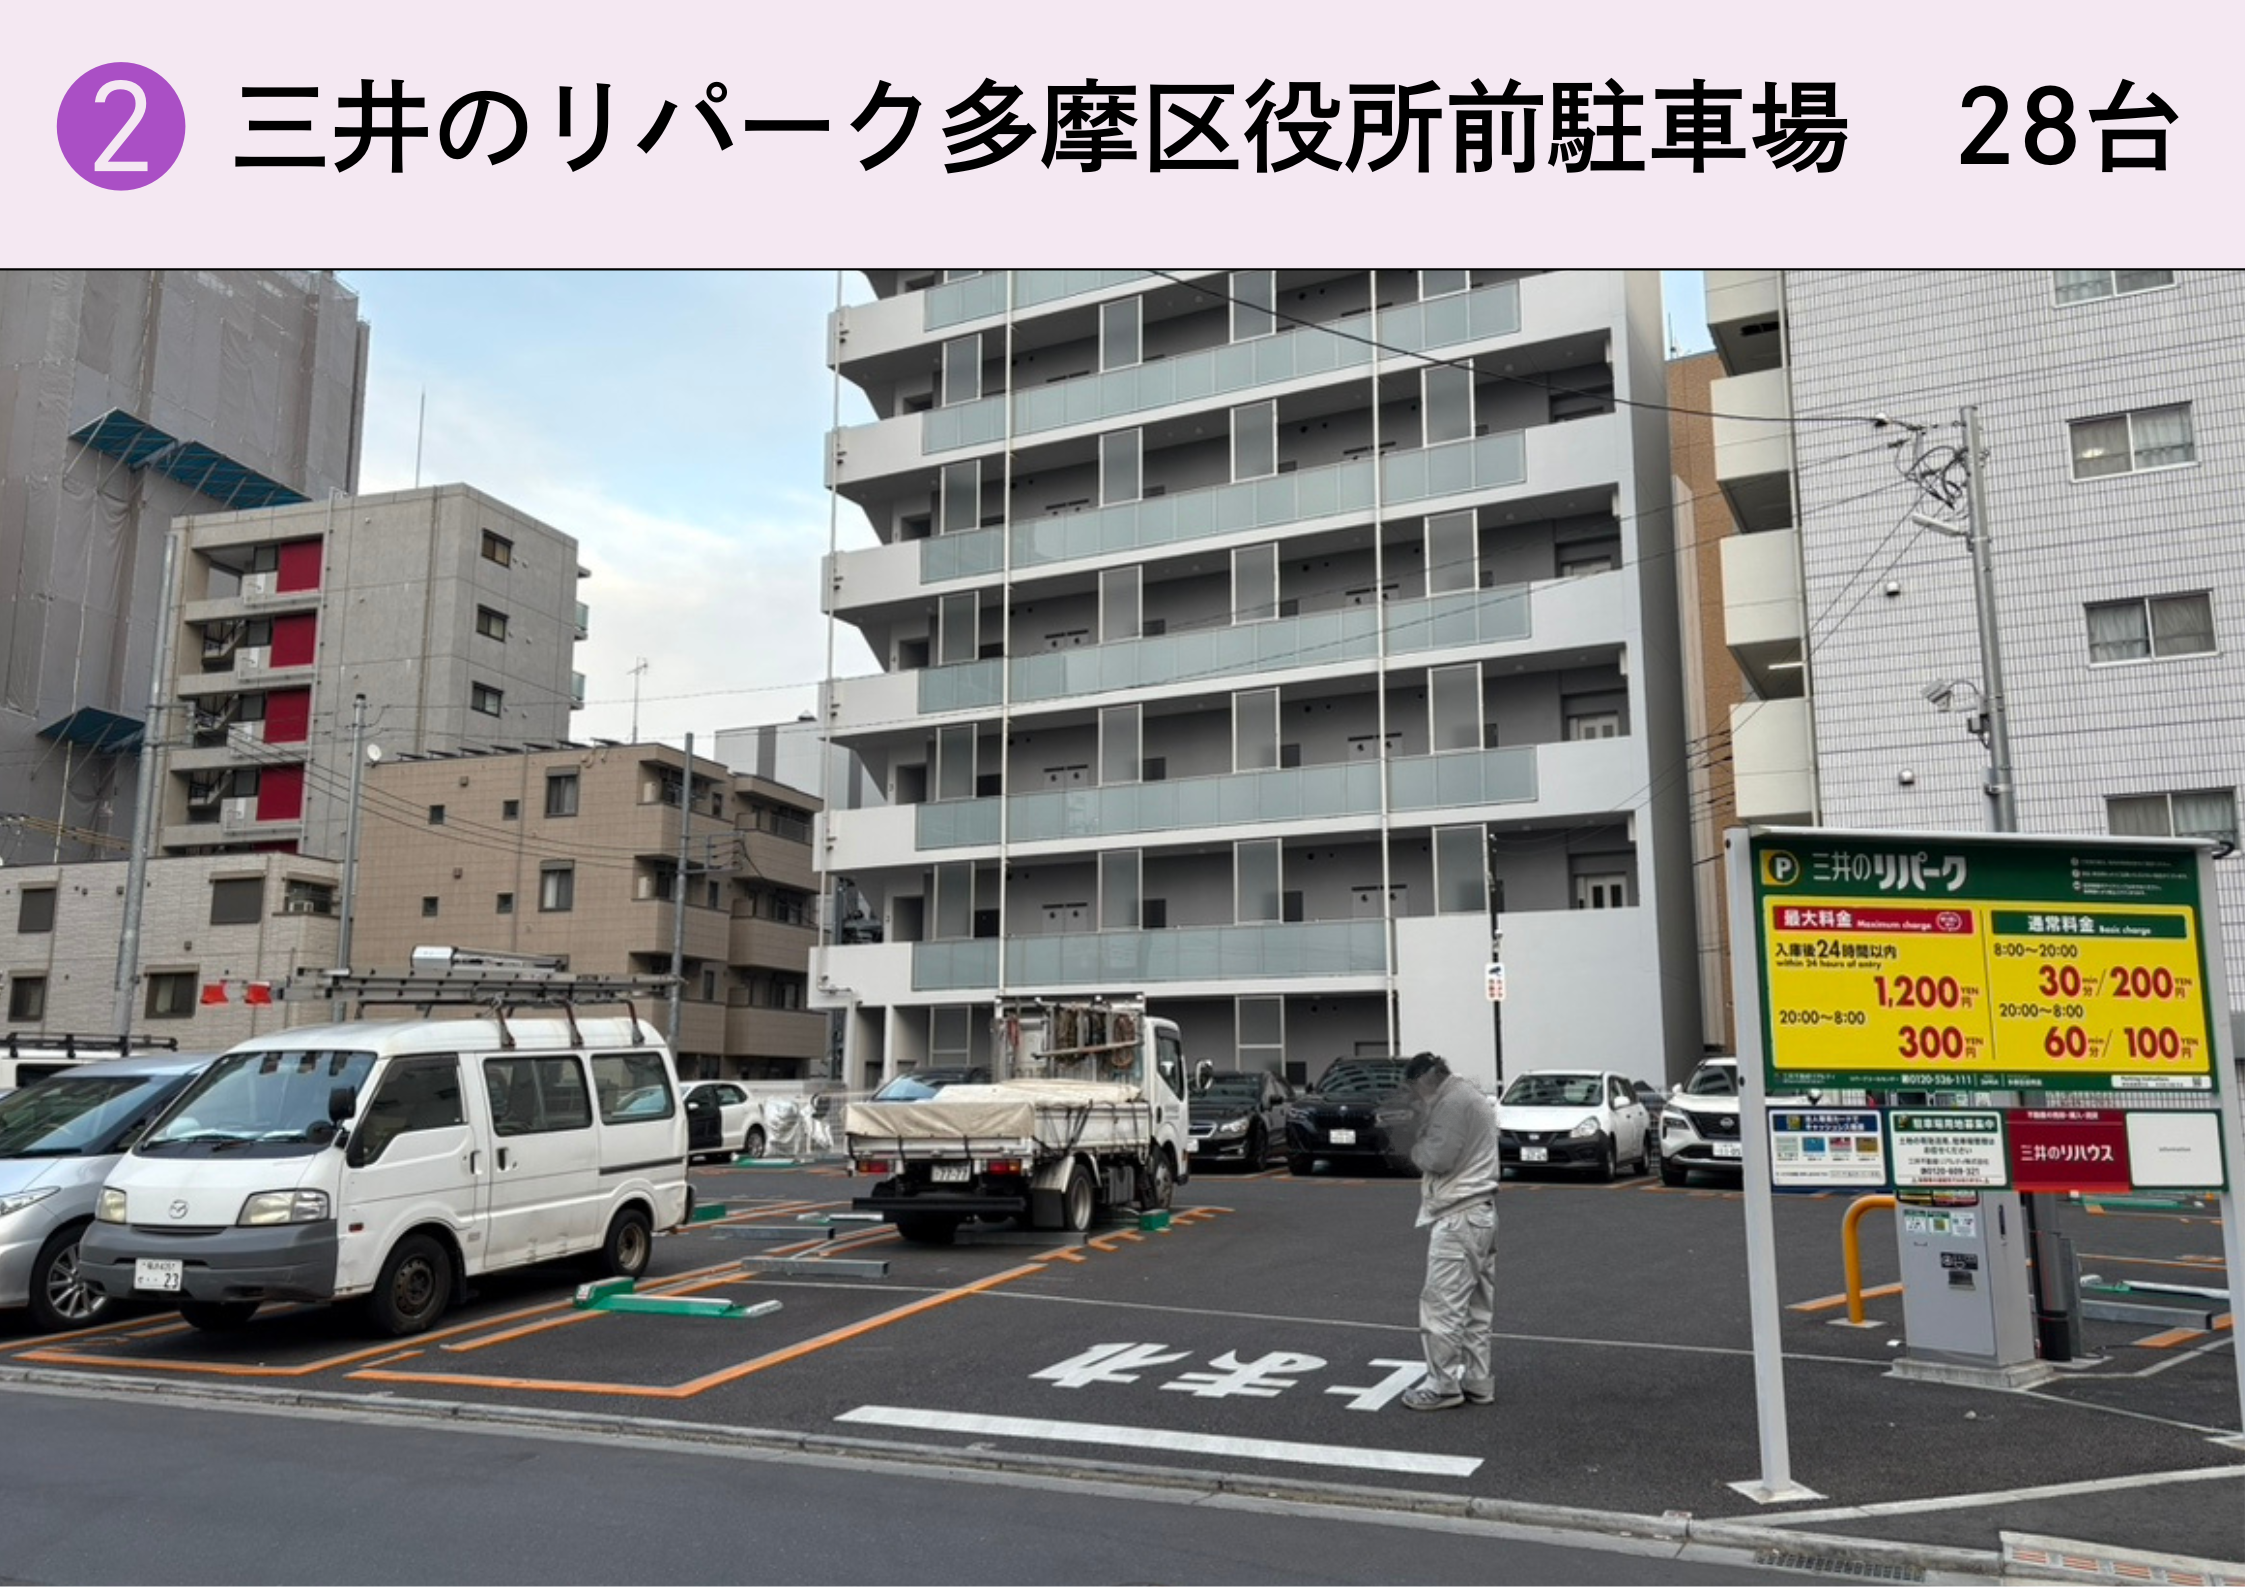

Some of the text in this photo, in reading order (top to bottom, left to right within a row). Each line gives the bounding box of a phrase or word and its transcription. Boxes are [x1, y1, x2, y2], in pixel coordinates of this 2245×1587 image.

[1812, 851, 1967, 891] 三井のリパーク
[1783, 909, 1853, 928] 最大料金
[1857, 919, 1900, 930] Maximum
[1902, 920, 1932, 932] charge
[2027, 915, 2095, 933] 通常料金
[2099, 925, 2151, 936] Basic charge
[1775, 939, 1898, 959] 入庫後24時間以内
[1776, 960, 1803, 968] within
[1805, 960, 1817, 968] 24
[1819, 960, 1845, 968] hours
[1846, 960, 1857, 969] of
[1874, 974, 1979, 1008] 1,200 YEN
[2039, 965, 2081, 997] 30
[2110, 966, 2173, 999] 200
[2175, 977, 2192, 986] YEN
[2083, 987, 2186, 998] 分 円
[1962, 996, 1973, 1008] 円
[1899, 1026, 1983, 1058] 300 YEN
[2044, 1025, 2087, 1058] 60
[2124, 1026, 2179, 1058] 100
[2181, 1038, 2198, 1046] YEN
[1966, 1046, 1977, 1058] 円
[2089, 1047, 2192, 1058] 分 円
[2020, 1144, 2114, 1162] 三井のリハウス
